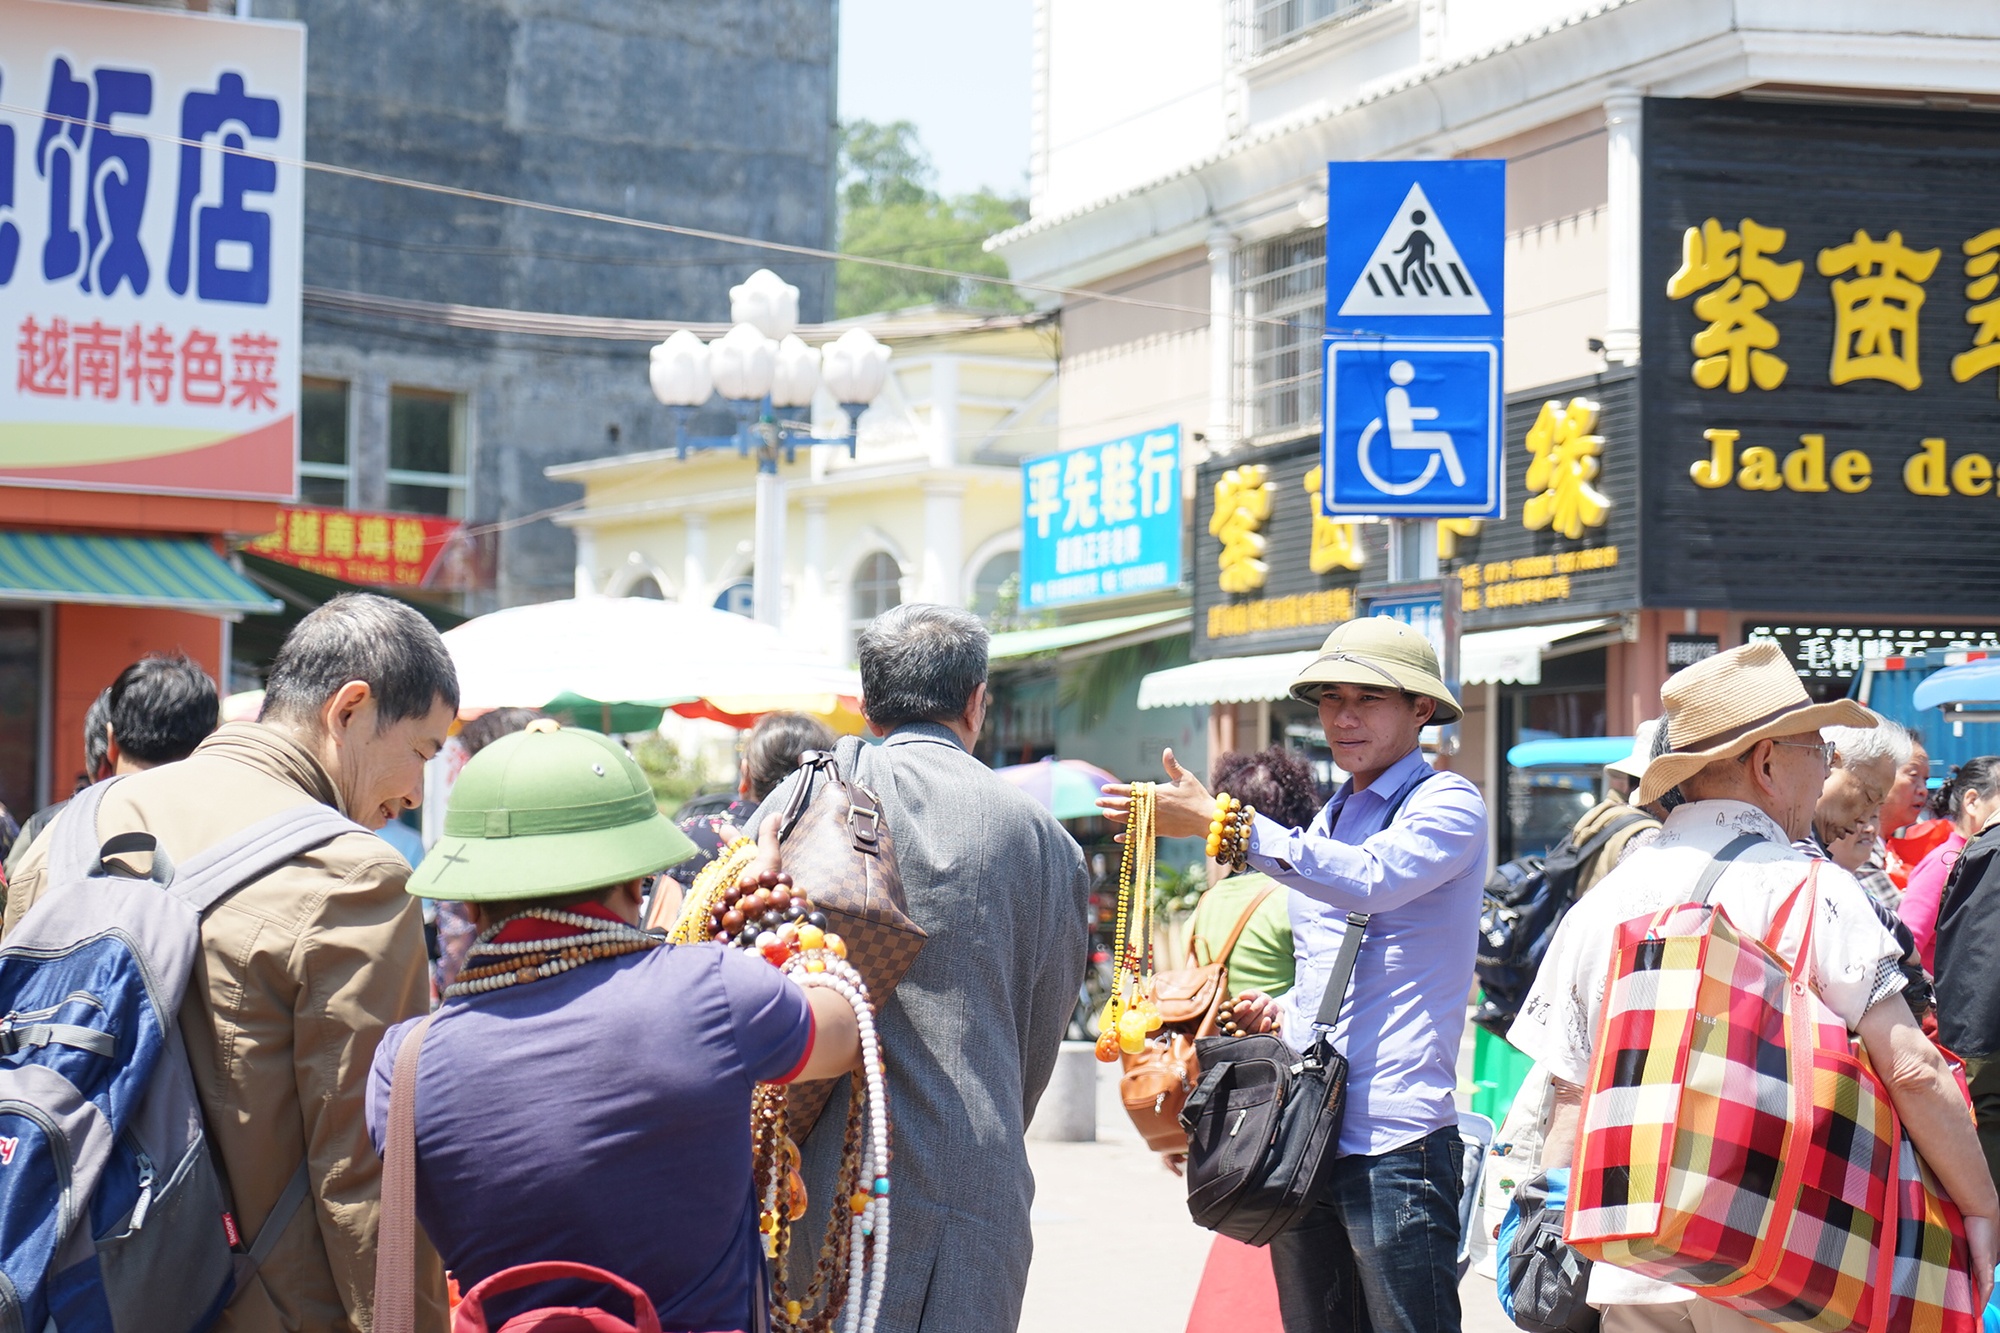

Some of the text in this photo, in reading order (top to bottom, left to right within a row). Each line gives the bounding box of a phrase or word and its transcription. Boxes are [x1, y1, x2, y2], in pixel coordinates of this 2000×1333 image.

[0, 57, 280, 305] 饭店
[16, 313, 280, 412] 越南特色菜
[1689, 427, 2000, 498] Jade de
